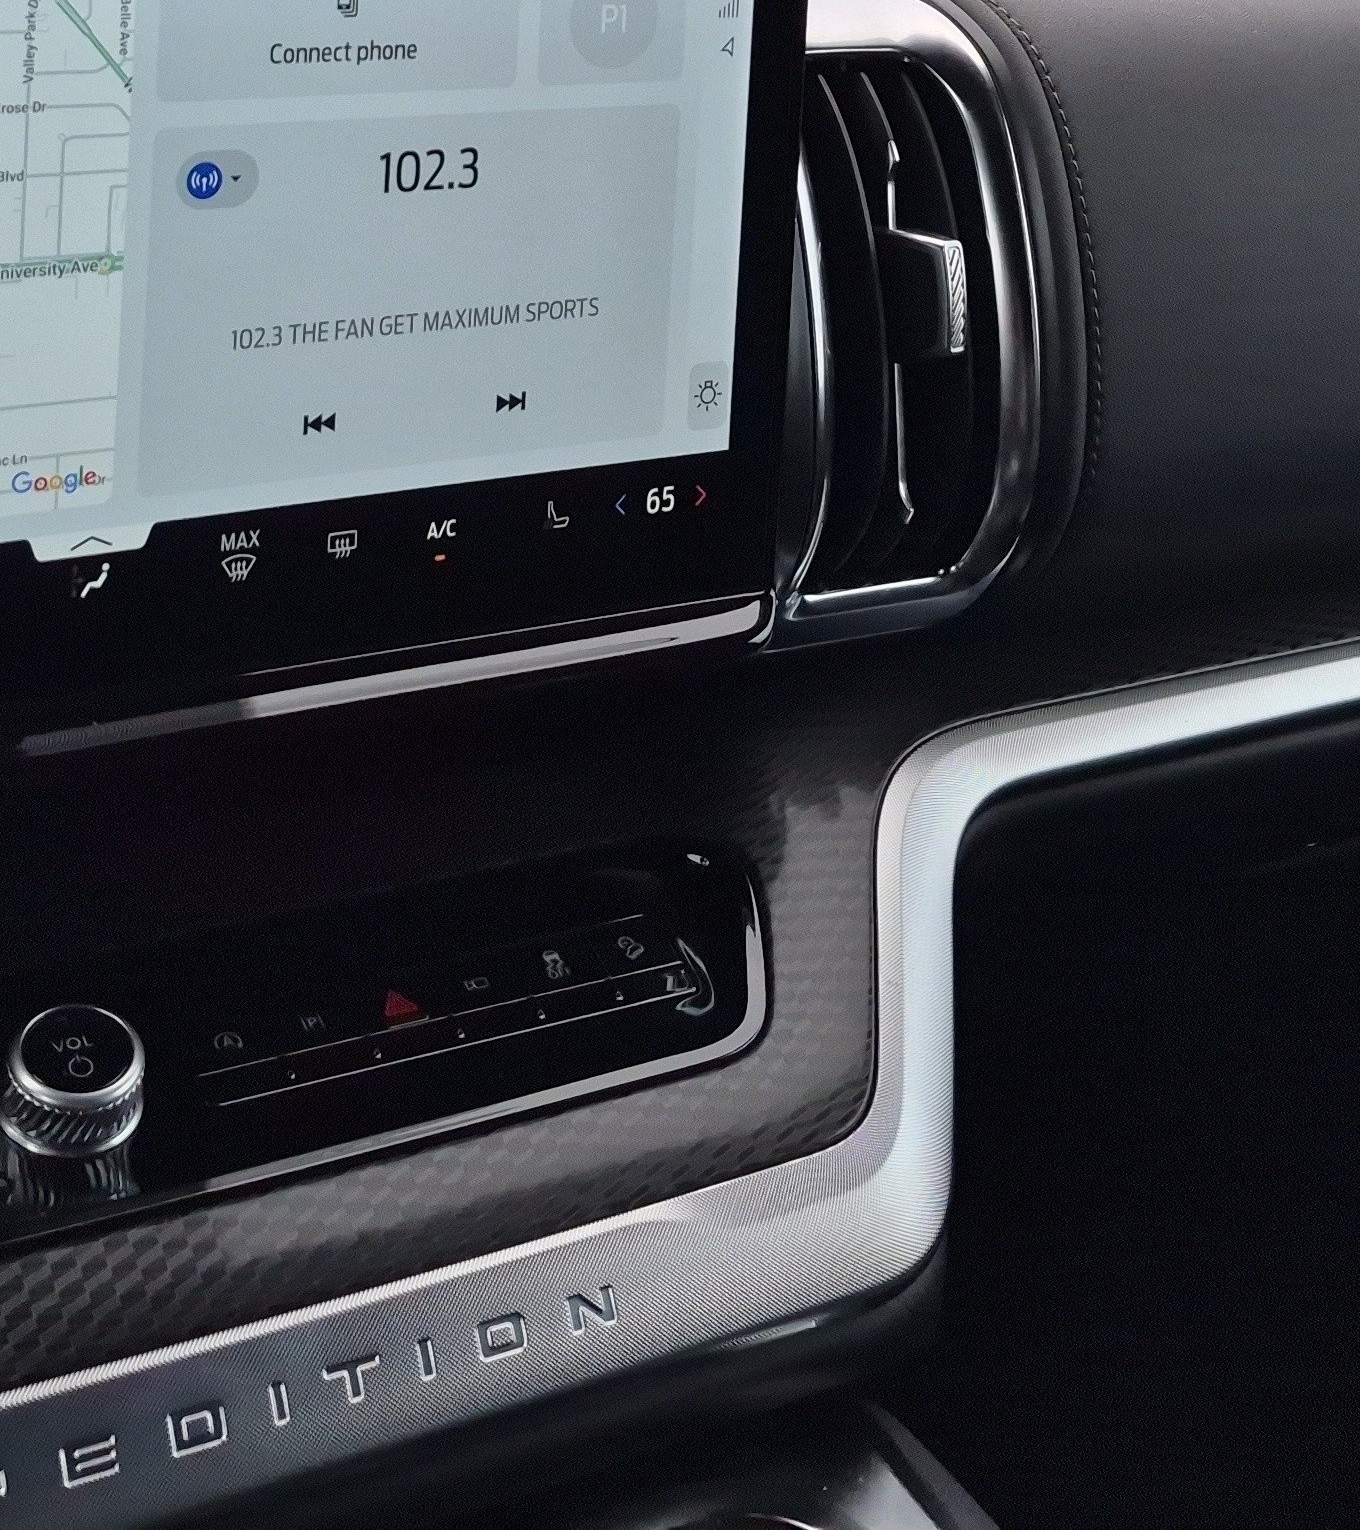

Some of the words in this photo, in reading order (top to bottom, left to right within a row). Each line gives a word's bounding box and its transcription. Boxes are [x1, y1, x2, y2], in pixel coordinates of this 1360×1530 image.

[24, 10, 37, 42] Park
[118, 31, 131, 56] Ave
[269, 40, 352, 65] Connect
[355, 39, 418, 65] phone
[22, 44, 39, 84] Valley
[31, 100, 48, 114] Dr
[379, 146, 481, 194] 102.3
[69, 259, 99, 274] Ave
[230, 325, 284, 351] 102.3
[289, 320, 330, 346] THE
[333, 316, 375, 342] FAN
[378, 312, 419, 336] GET
[422, 302, 521, 332] MAXIMUM
[524, 296, 600, 323] SPORTS
[11, 453, 28, 466] Ln
[11, 464, 97, 495] Google
[645, 485, 677, 515] 65
[220, 529, 261, 552] MAX
[426, 518, 457, 541] A/C
[51, 1032, 95, 1055] VOL
